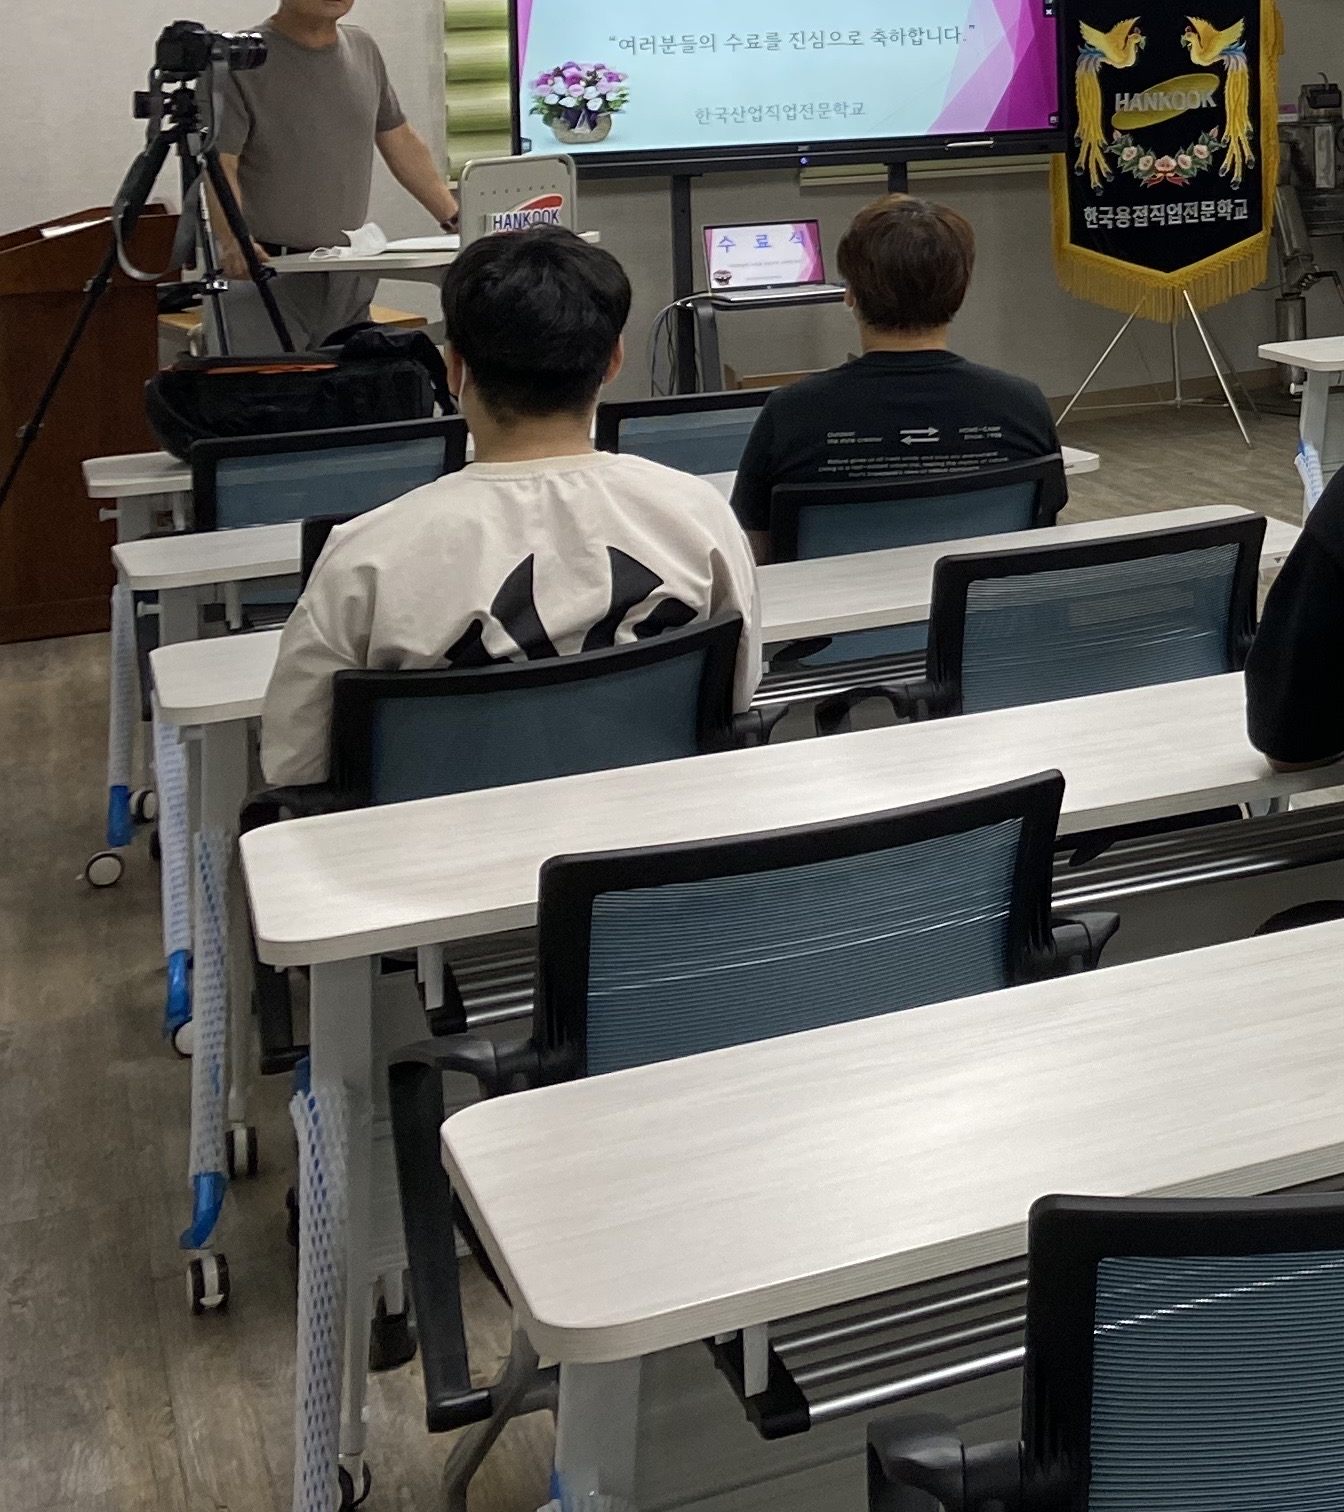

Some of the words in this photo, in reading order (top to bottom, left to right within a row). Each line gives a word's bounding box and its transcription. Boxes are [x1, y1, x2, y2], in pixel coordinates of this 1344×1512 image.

[723, 31, 783, 53] 수료를
[787, 29, 864, 50] 진심으로
[695, 100, 866, 126] 한국산업직업전문학교
[1114, 90, 1217, 113] HANKOOK
[492, 208, 560, 231] HANKOOK
[1083, 199, 1249, 229] 한국용접직업전문학교
[717, 235, 736, 253] 수
